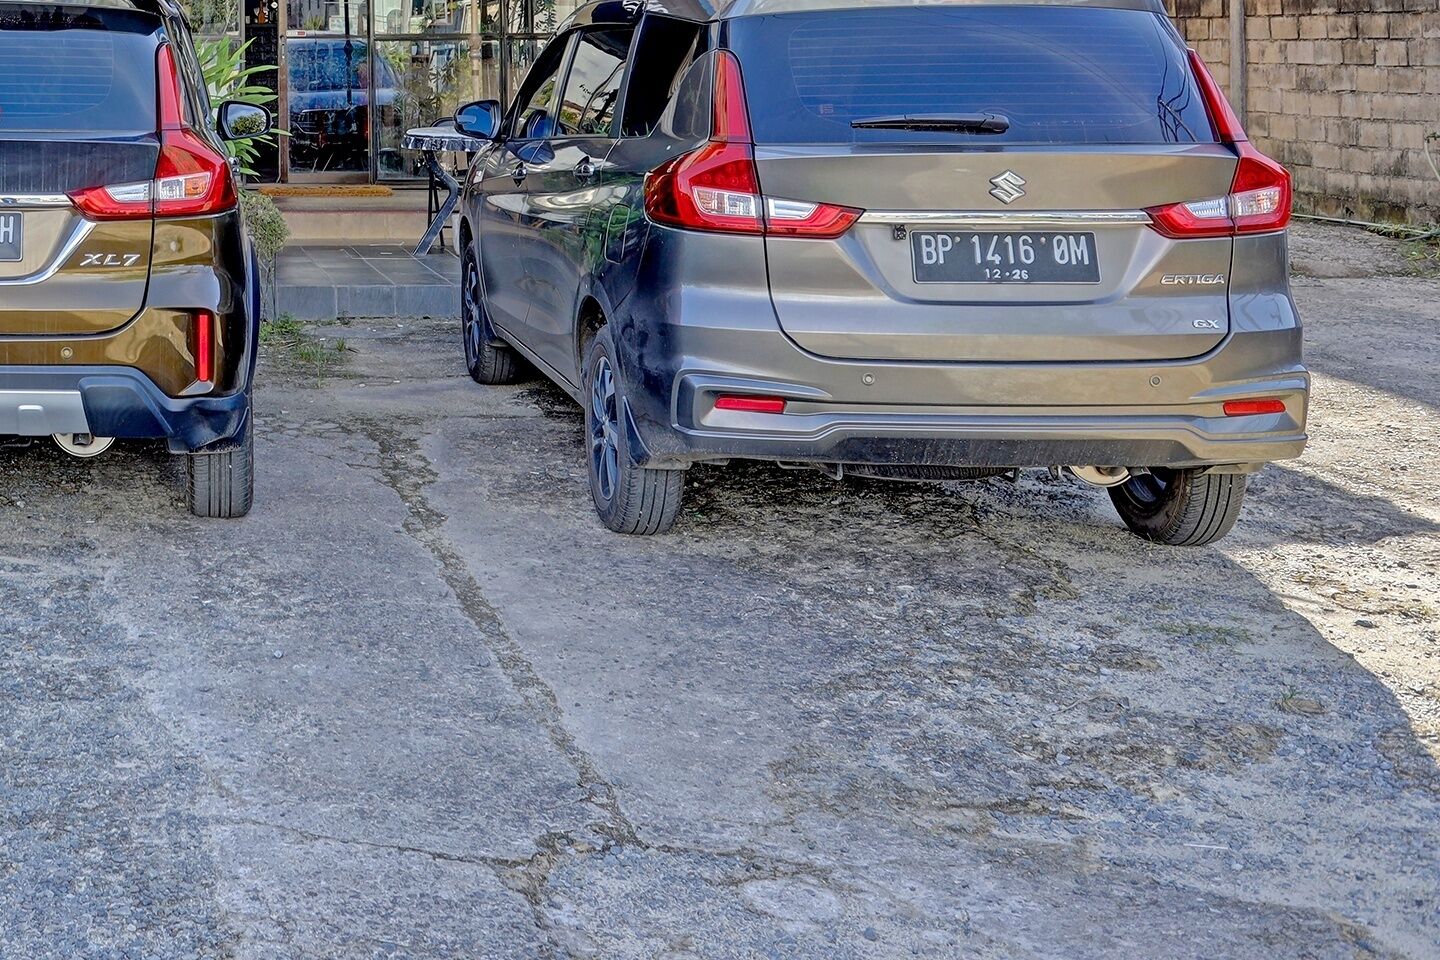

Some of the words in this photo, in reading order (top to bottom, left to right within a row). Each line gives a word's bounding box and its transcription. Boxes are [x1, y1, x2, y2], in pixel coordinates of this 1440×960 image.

[0, 215, 14, 243] H
[920, 234, 953, 265] BP
[971, 235, 1035, 265] 1416
[80, 253, 140, 267] XL7
[1161, 273, 1225, 285] ERTIGA
[1192, 319, 1220, 329] GX
